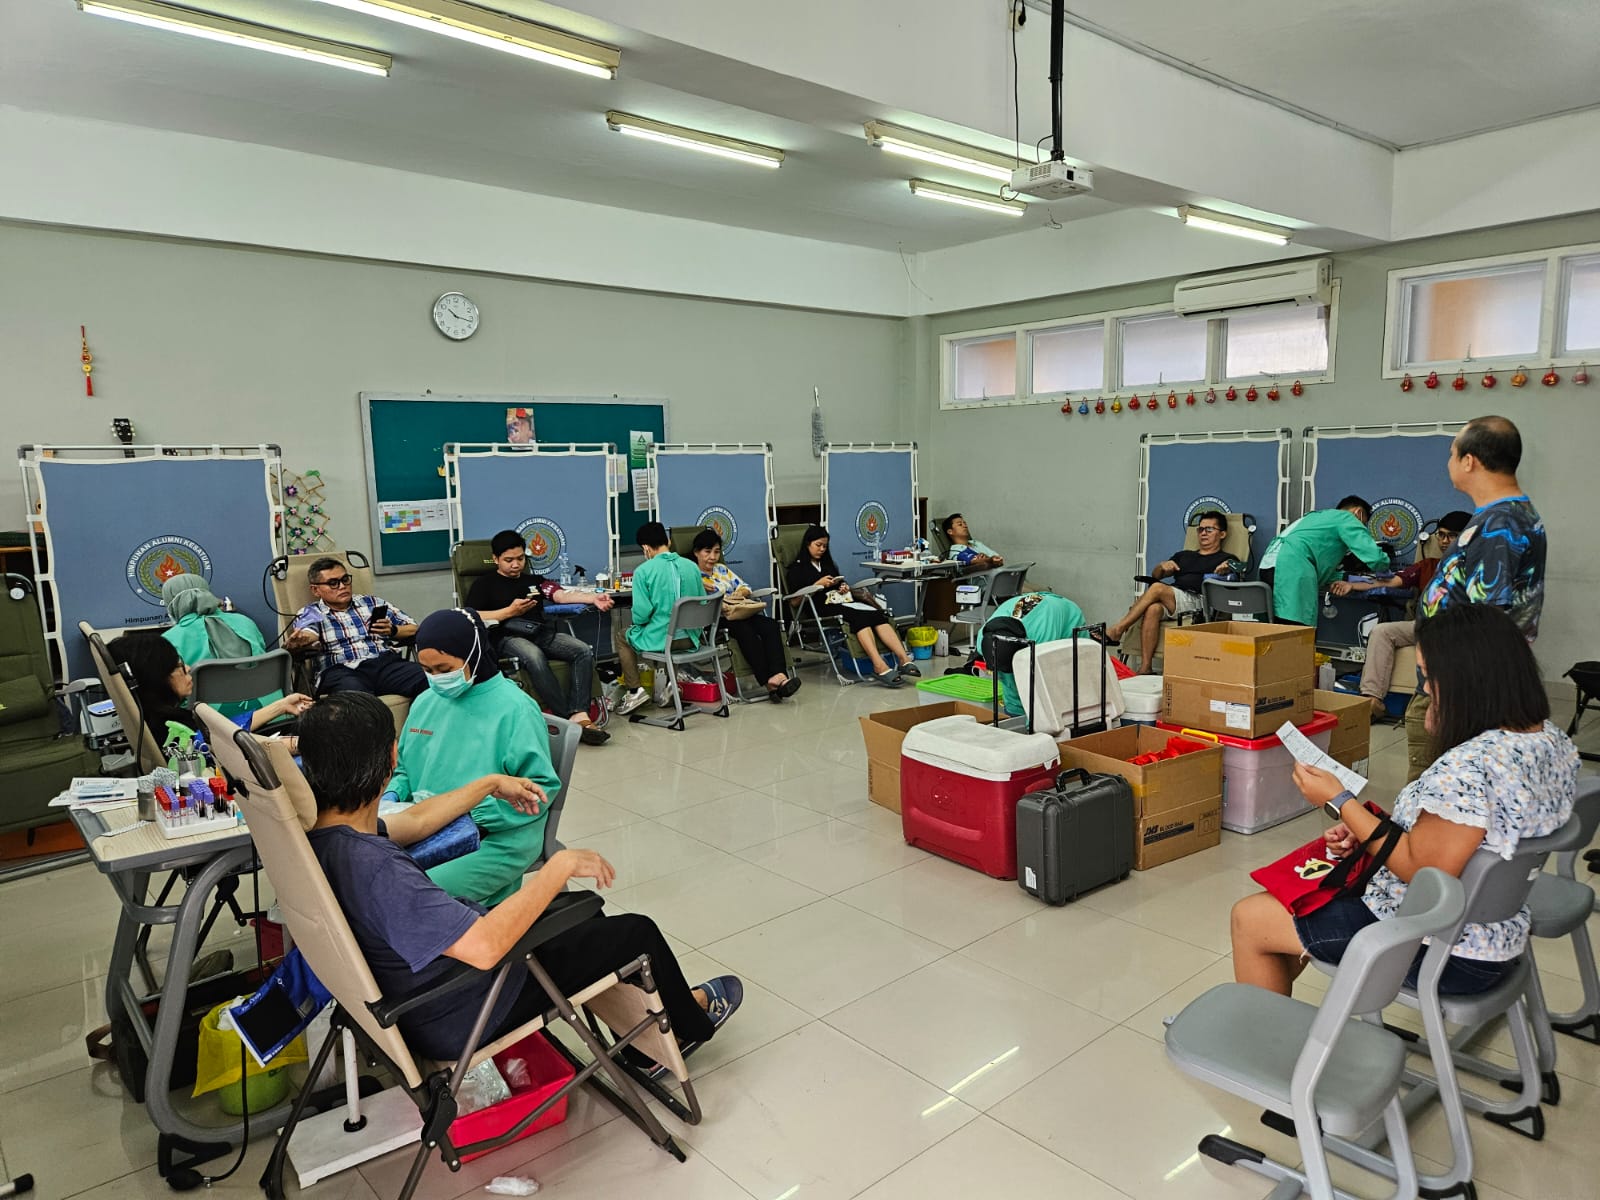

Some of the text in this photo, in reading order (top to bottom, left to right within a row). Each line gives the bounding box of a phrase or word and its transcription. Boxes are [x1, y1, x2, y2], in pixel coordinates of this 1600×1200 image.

[1381, 498, 1404, 506] ALUMNI
[127, 536, 211, 577] HIMPUNAN ALUMNI KESATUAN
[125, 614, 162, 624] Himpunan
